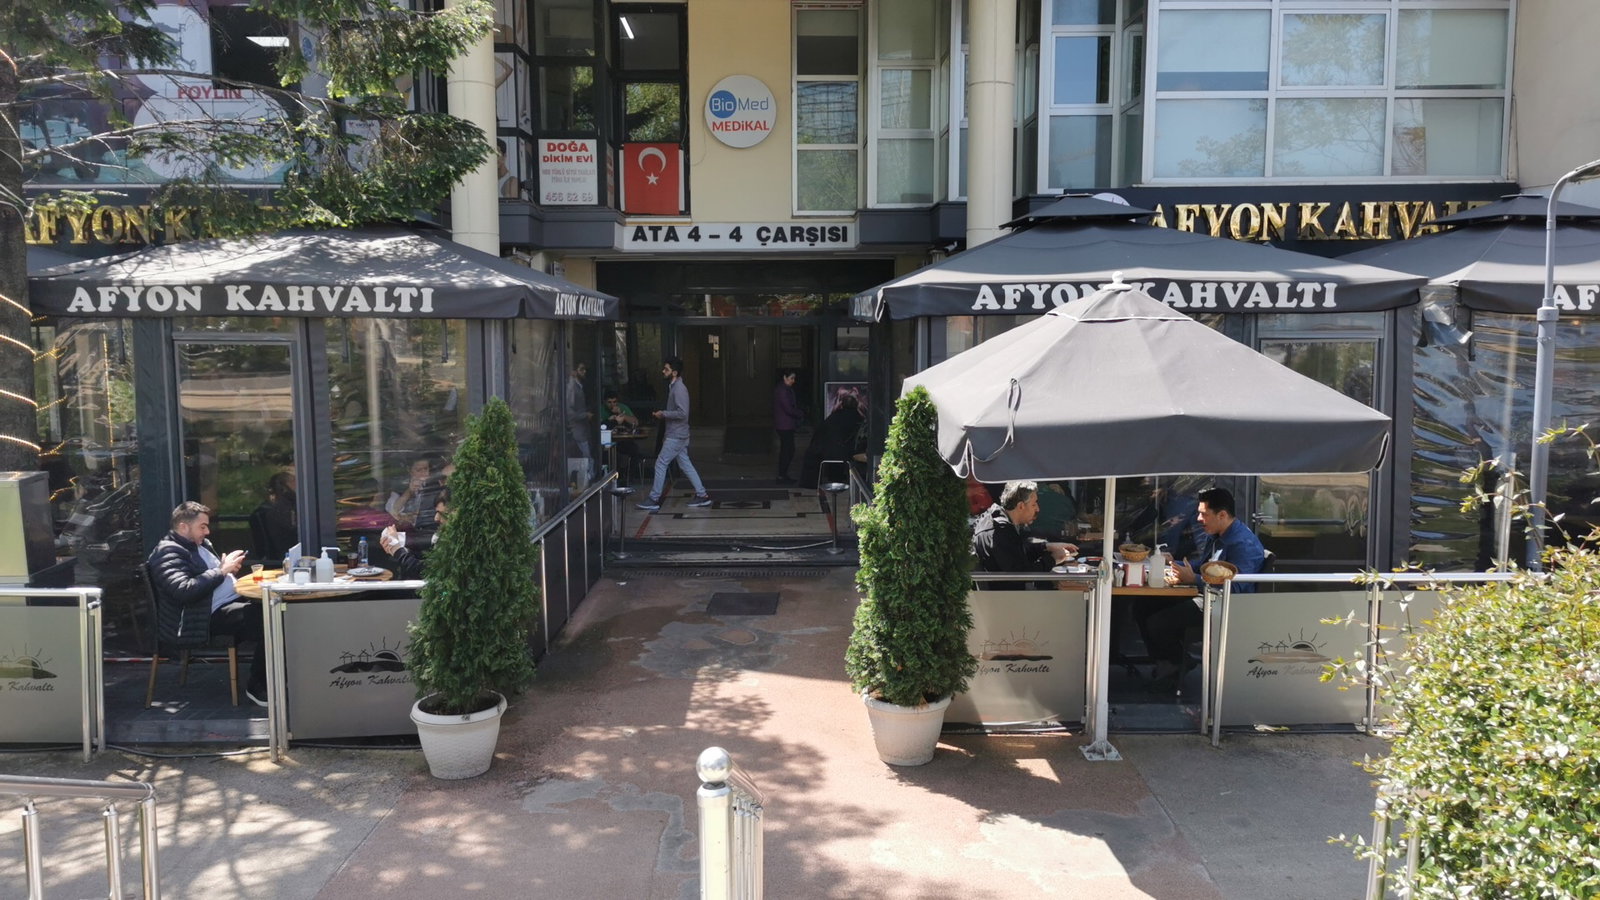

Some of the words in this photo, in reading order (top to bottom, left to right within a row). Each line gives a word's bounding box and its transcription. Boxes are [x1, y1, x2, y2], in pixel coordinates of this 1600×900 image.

[546, 141, 589, 153] DOĞA
[542, 154, 573, 163] DİKİM
[576, 154, 594, 163] EVİ
[25, 204, 154, 245] FYON
[1151, 202, 1291, 242] AFYON
[632, 225, 680, 242] ATA
[688, 225, 701, 242] 4
[729, 225, 743, 242] 4
[756, 225, 848, 247] ÇARŞISI
[67, 286, 203, 313] AFYON
[226, 285, 435, 314] KAHVALTI
[1246, 665, 1279, 679] Afyon
[329, 676, 363, 689] Afyon
